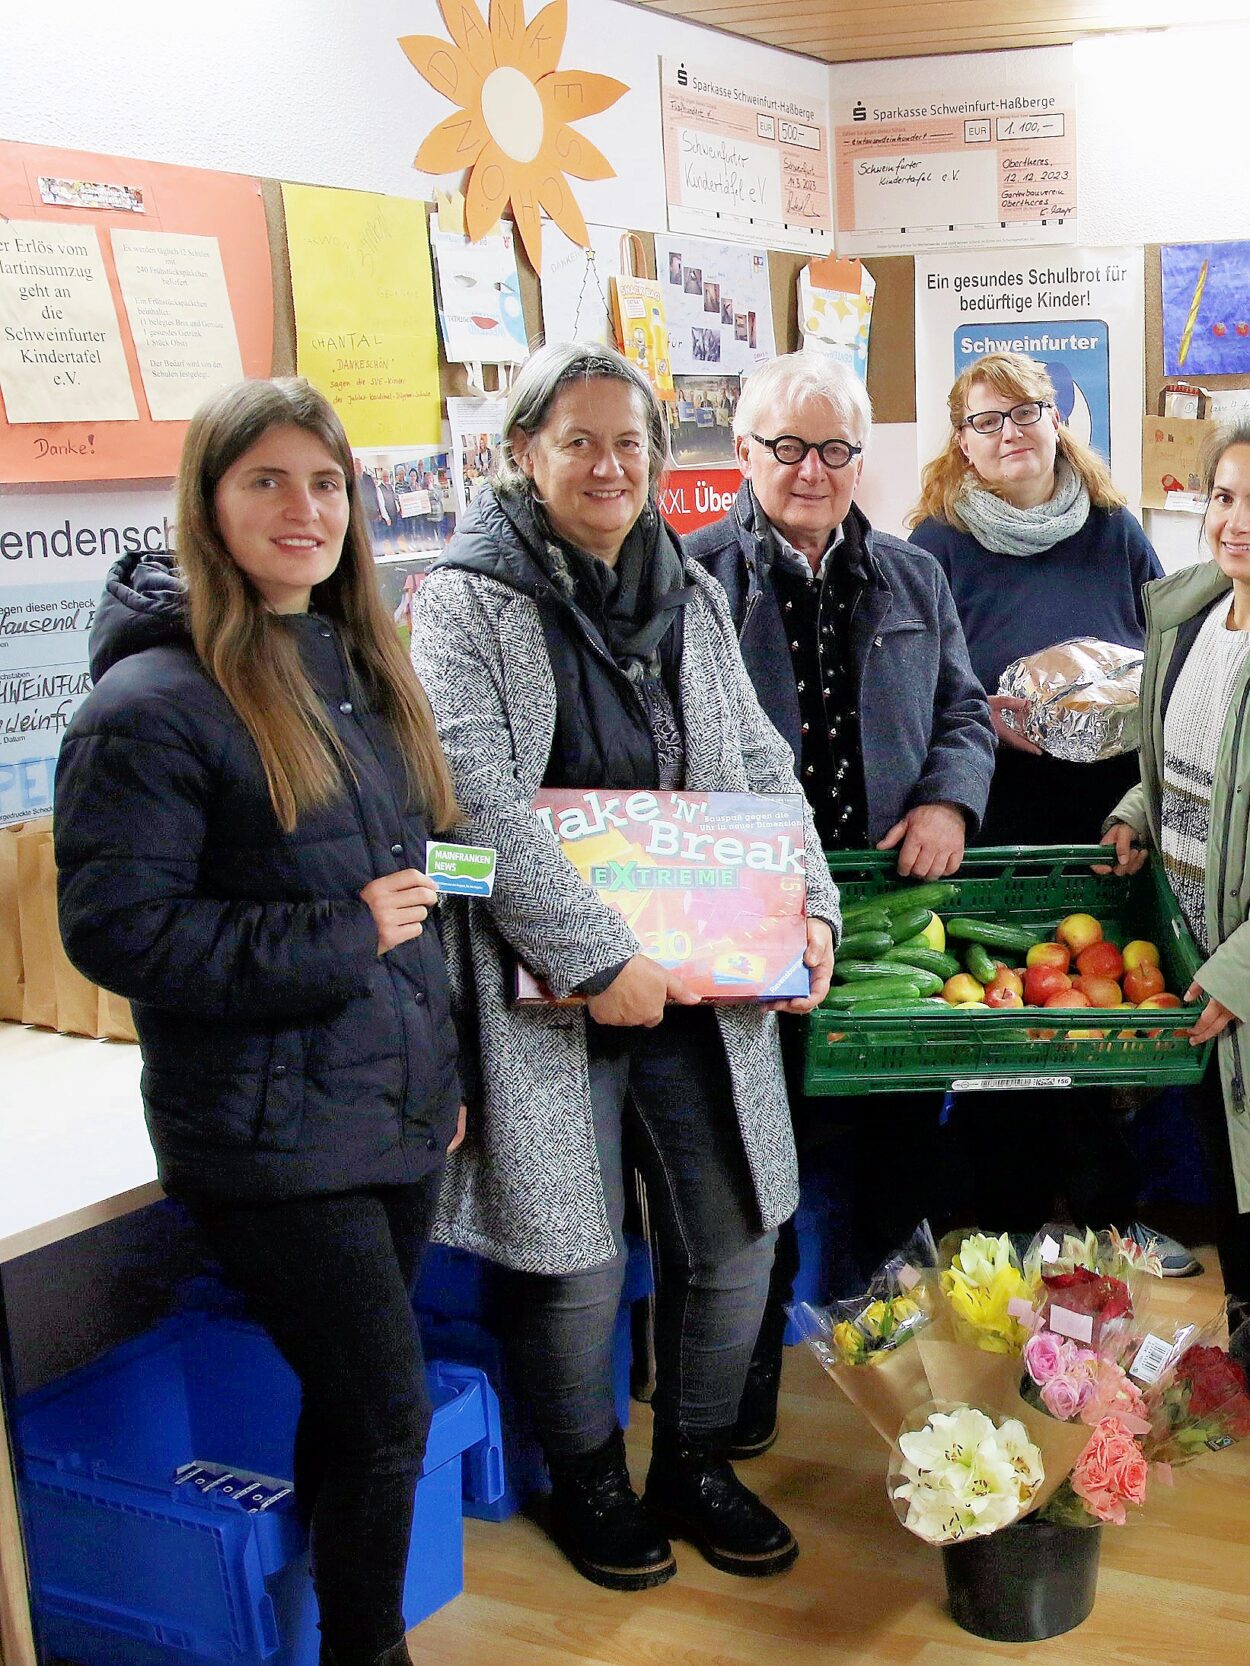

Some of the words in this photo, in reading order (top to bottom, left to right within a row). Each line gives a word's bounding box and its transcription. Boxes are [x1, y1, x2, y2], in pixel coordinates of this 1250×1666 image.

[692, 77, 732, 99] Sparkasse
[733, 88, 816, 120] Schweinfurt-Haßberge
[873, 107, 928, 121] Sparkasse
[930, 96, 1056, 116] Schweinfurt-Haßberge
[760, 121, 772, 132] EUR
[968, 126, 988, 136] EUR
[15, 238, 53, 255] Erlös
[57, 244, 88, 256] vom
[0, 260, 93, 281] artinsumzug
[927, 273, 949, 290] Ein
[953, 270, 1024, 293] gesundes
[1028, 266, 1101, 285] Schulbrot
[1105, 265, 1128, 283] für
[18, 286, 50, 302] geht
[54, 287, 71, 298] an
[960, 293, 1033, 313] bedürftige
[1037, 290, 1091, 309] Kinder!
[41, 304, 63, 320] die
[5, 326, 106, 343] Schweinfurter
[311, 332, 382, 354] CHANTAL
[960, 334, 1100, 354] Schweinfurter
[20, 349, 101, 364] Kindertafel
[53, 371, 80, 386] e.V.
[33, 433, 95, 460] Danke!
[659, 487, 692, 515] XXL
[26, 601, 58, 613] diesen
[60, 598, 95, 611] Scheck
[3, 735, 26, 745] Datum
[645, 818, 807, 875] Break
[434, 849, 491, 865] MAINFRANKEN
[434, 861, 457, 872] NEWS
[594, 860, 733, 893] EXTREME
